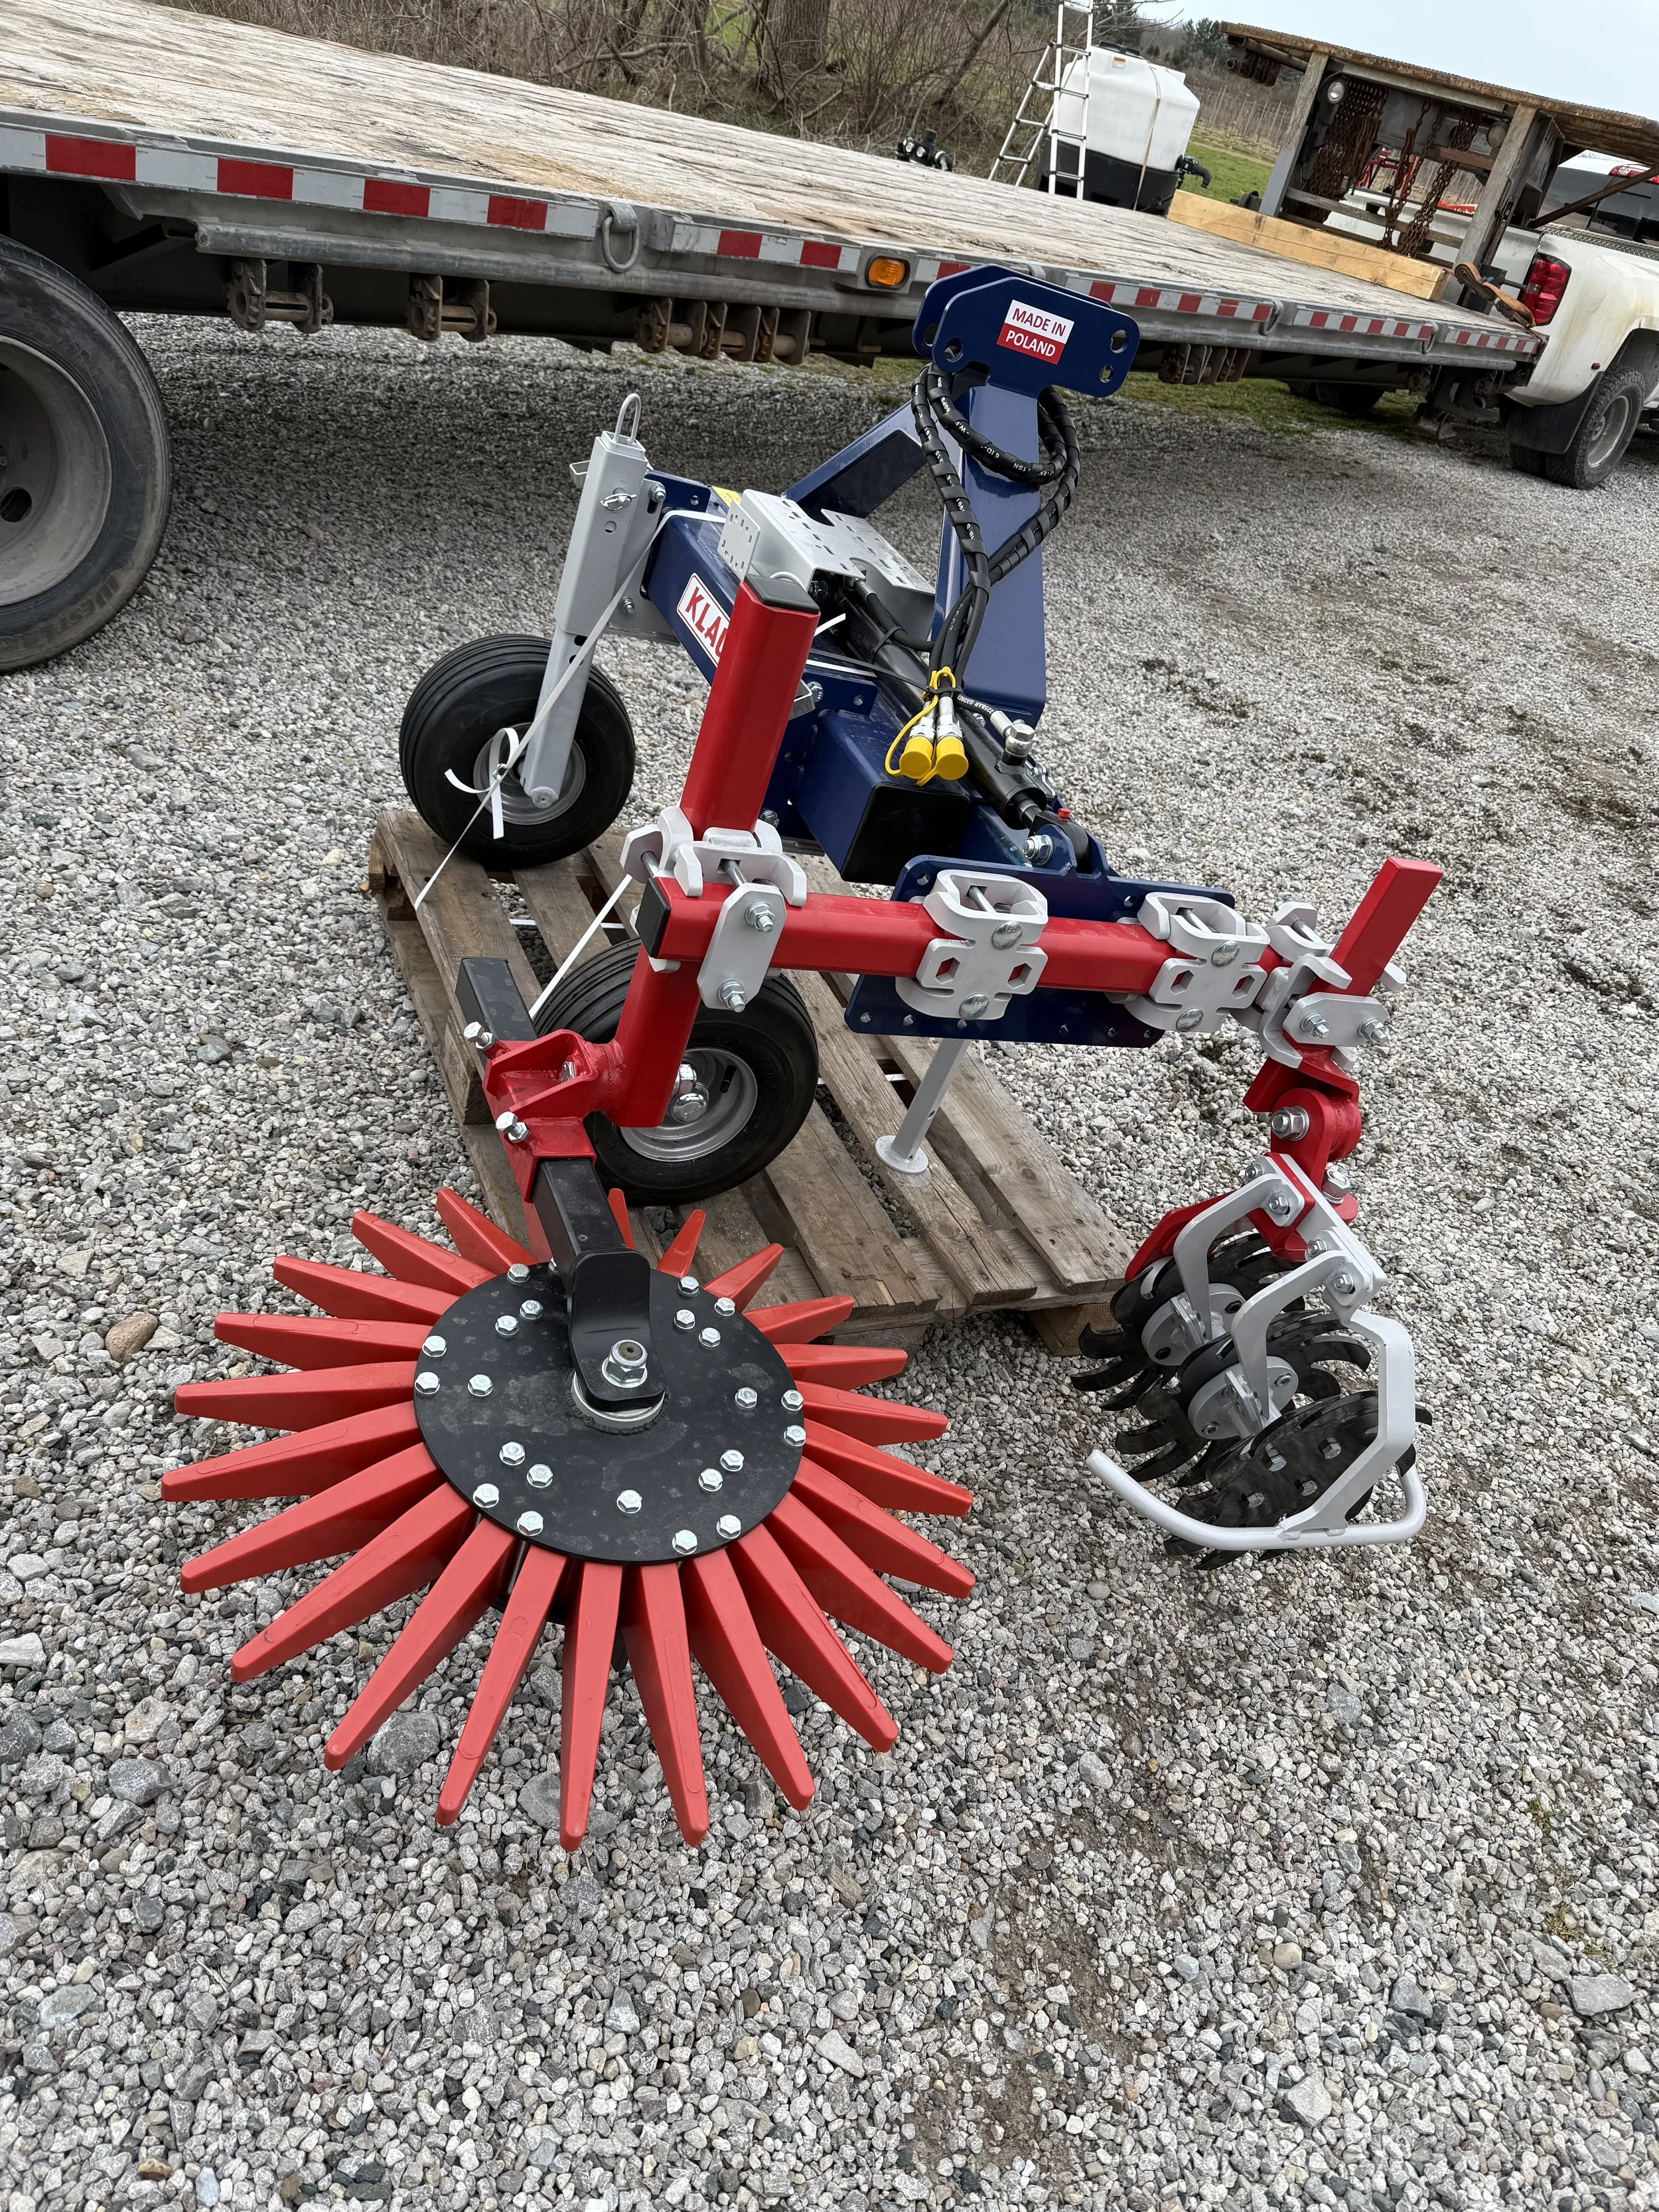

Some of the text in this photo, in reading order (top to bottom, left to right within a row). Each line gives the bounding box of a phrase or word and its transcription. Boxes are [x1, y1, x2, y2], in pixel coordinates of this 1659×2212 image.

[1012, 307, 1066, 337] MADE IN
[1005, 329, 1056, 357] POLAND
[974, 701, 995, 714] 225BAR
